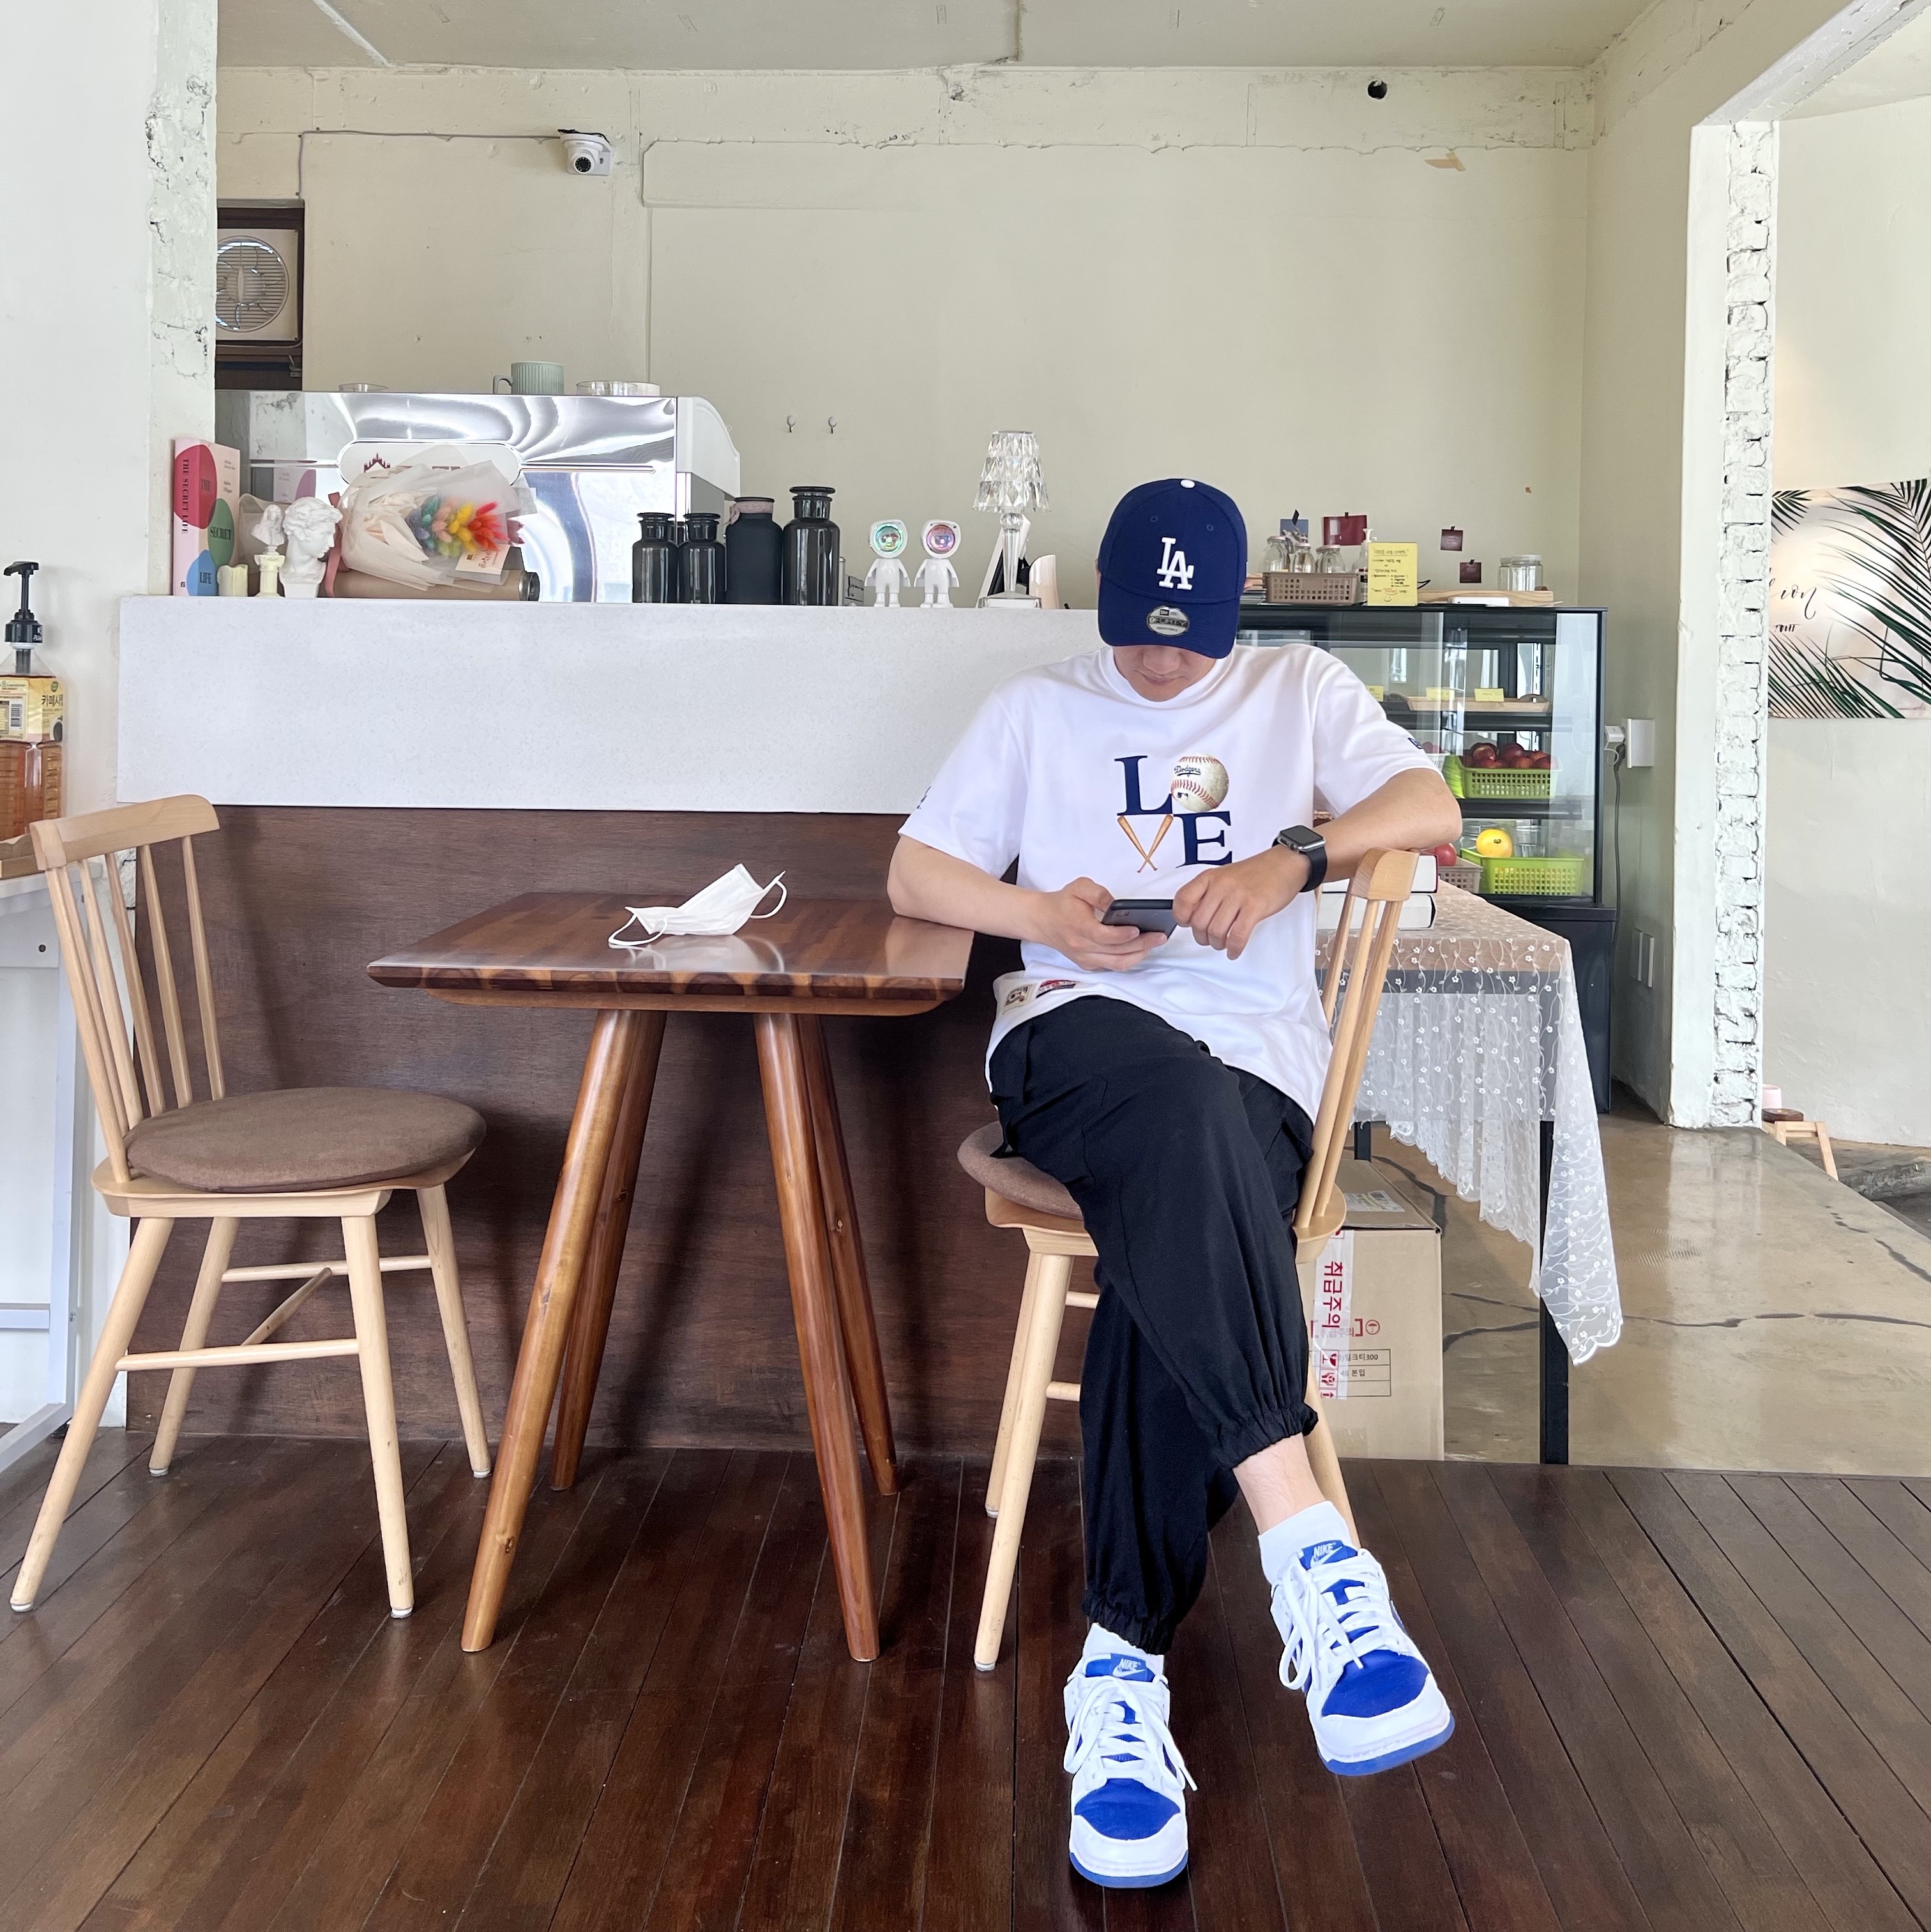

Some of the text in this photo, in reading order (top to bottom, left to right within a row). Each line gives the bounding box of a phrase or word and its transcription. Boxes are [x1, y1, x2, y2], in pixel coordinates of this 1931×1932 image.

[201, 478, 211, 492] THE
[210, 526, 232, 540] SECRET
[1156, 536, 1195, 590] LA
[200, 572, 212, 584] LIFE
[1174, 764, 1201, 777] Dodgers
[1321, 1261, 1344, 1328] 취급주의
[1314, 1543, 1333, 1558] NIKE
[1119, 1658, 1138, 1670] NIKE
